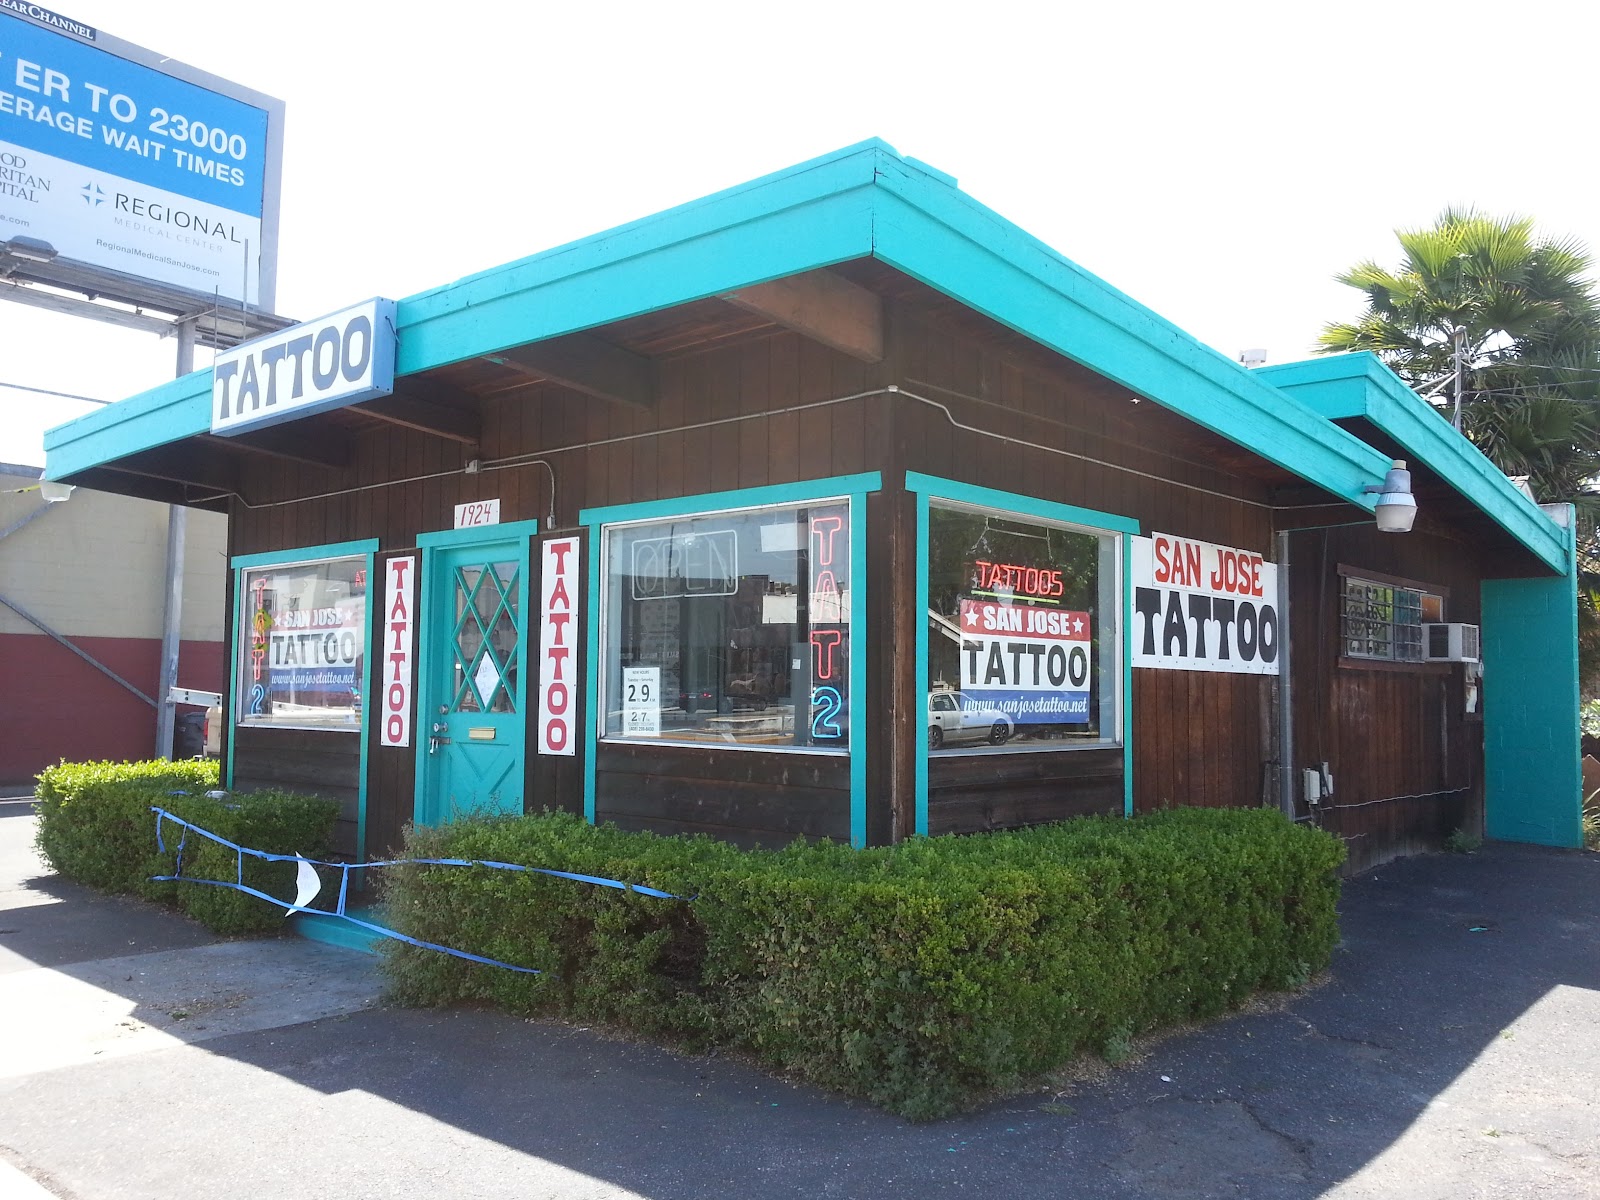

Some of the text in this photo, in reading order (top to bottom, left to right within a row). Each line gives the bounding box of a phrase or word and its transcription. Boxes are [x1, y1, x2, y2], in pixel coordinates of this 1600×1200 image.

[15, 58, 247, 160] ER TO 23000
[102, 125, 165, 161] WAIT
[172, 148, 245, 187] TIMES
[0, 182, 39, 203] ITAL
[114, 217, 223, 253] MEDICAL CENTER
[115, 192, 241, 244] REGIONAL
[96, 238, 220, 277] RegionalMedicalSanJose.com
[215, 315, 371, 420] TATTOO
[461, 503, 492, 526] 1924
[636, 538, 734, 597] OPEN
[976, 560, 1064, 596] TATTOOS
[1154, 537, 1264, 597] SAN JOSE
[284, 608, 343, 628] SAN JOSE
[810, 517, 842, 738] TAT2
[984, 605, 1071, 636] SAN JOSE
[1136, 586, 1279, 663] TATTOO
[272, 632, 356, 664] TATTOO
[387, 561, 409, 743] TATTOO
[546, 542, 571, 751] TATTOO
[962, 643, 1088, 687] TATTOO
[271, 672, 355, 688] www.sanjosetattoo.net
[628, 684, 650, 702] 2 9
[631, 711, 647, 722] 2 7
[963, 696, 1088, 716] www.sanjosetattoo.net
